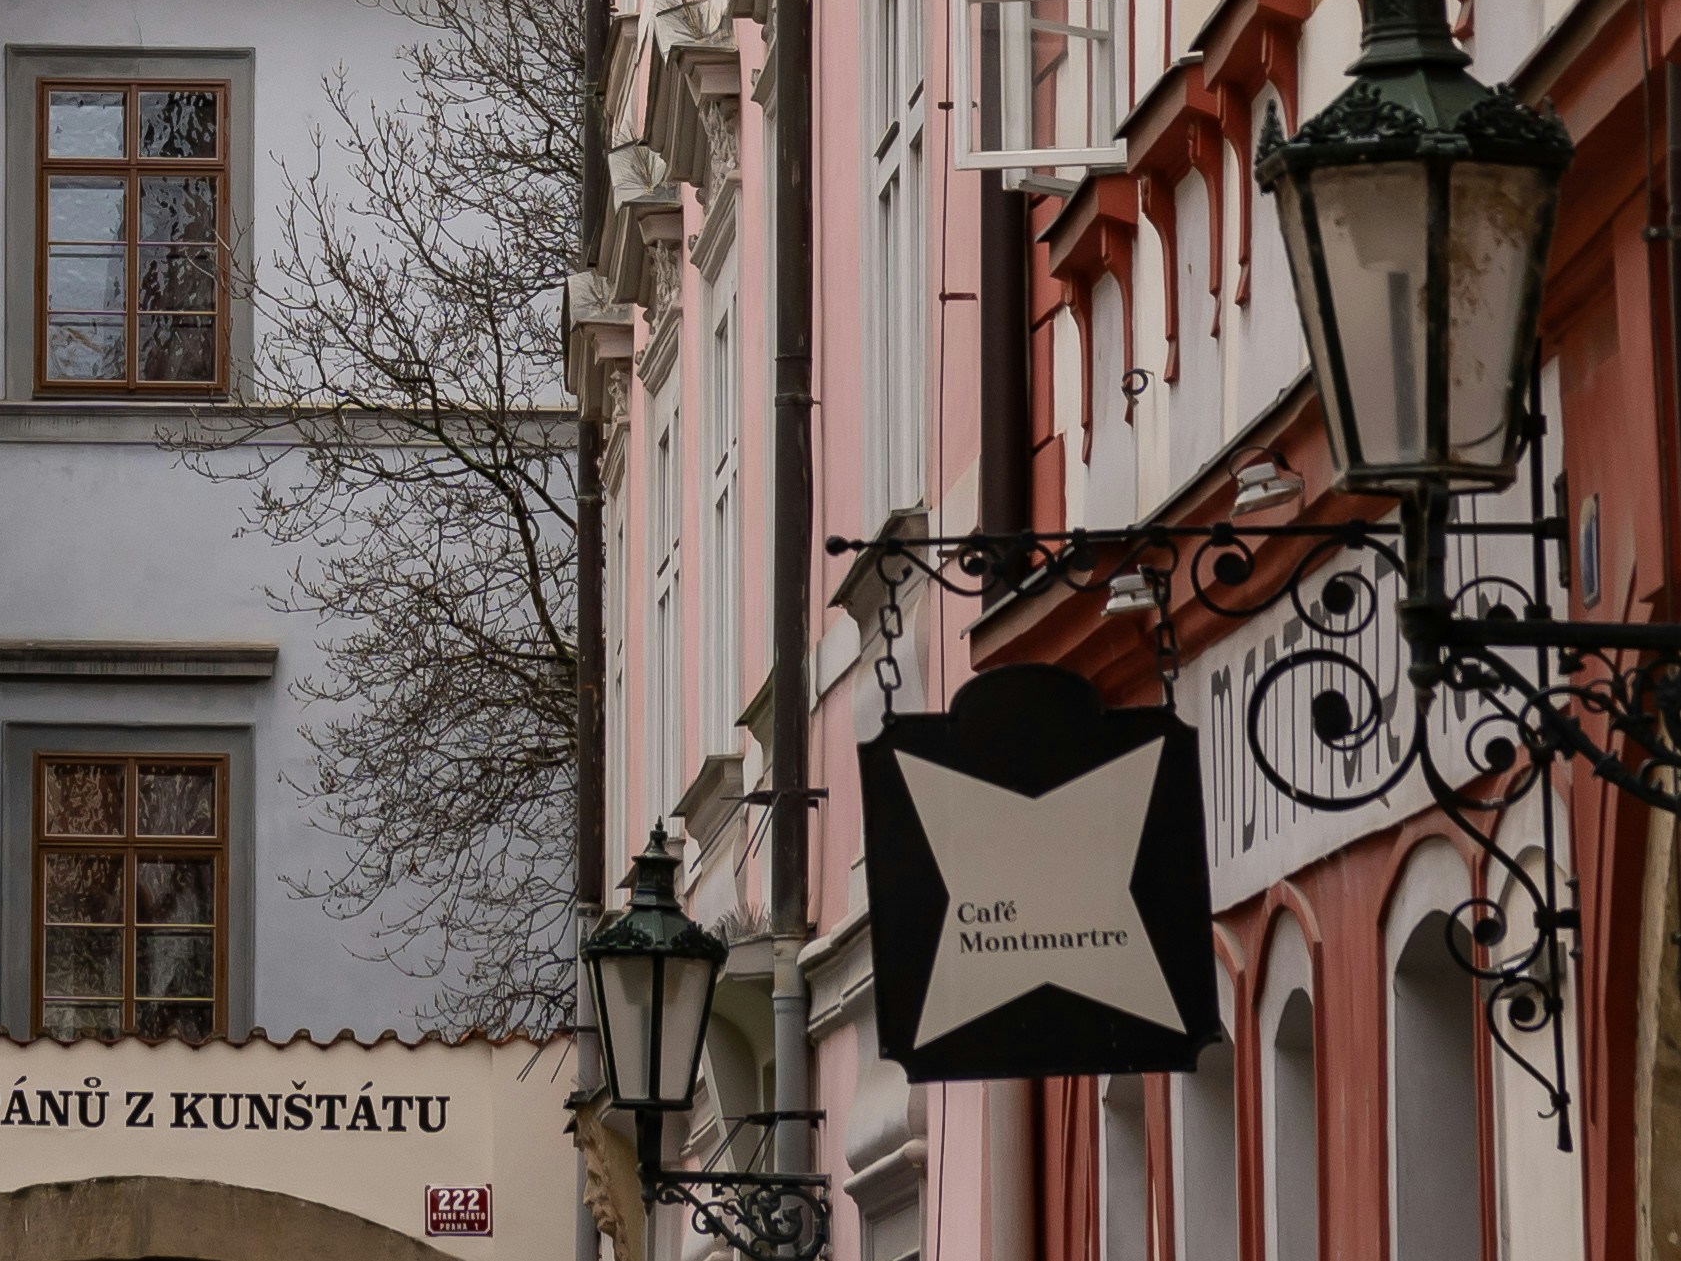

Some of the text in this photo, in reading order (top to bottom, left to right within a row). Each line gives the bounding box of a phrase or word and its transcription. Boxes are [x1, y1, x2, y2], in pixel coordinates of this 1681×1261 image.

[957, 900, 1017, 926] Café
[959, 928, 1129, 954] Montmartre
[125, 1091, 154, 1128] Z
[170, 1080, 451, 1133] KUNŠTÁTU
[438, 1189, 480, 1211] 222
[439, 1222, 468, 1231] PRAHA
